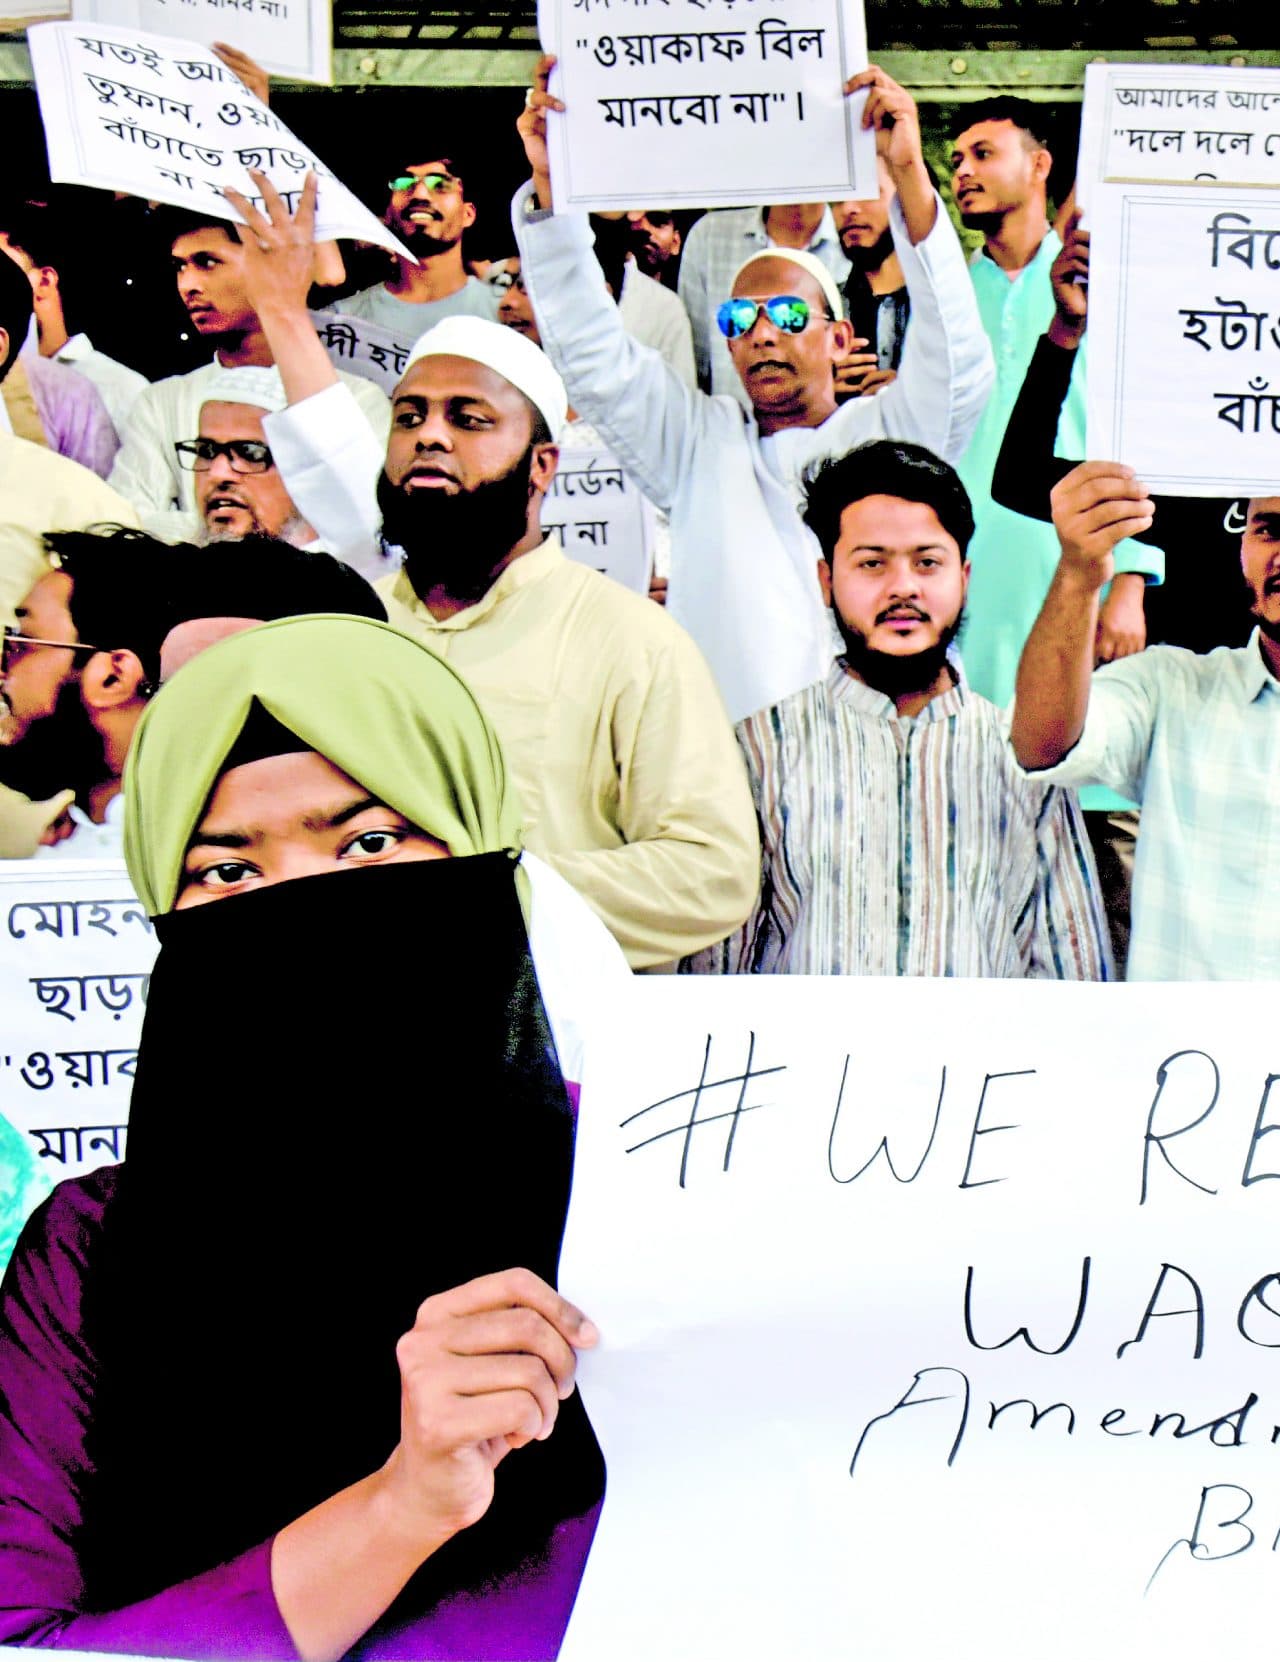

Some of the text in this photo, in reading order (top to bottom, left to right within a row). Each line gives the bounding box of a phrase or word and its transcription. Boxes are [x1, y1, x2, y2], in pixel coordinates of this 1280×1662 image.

[74, 36, 164, 78] যতই
[576, 18, 825, 68] "ওয়াকাফ বিল
[82, 72, 283, 133] তুফান, ওয়া
[597, 94, 722, 128] মানবো
[1114, 88, 1219, 108] আমাদের
[98, 115, 224, 169] বাঁচাতে
[1193, 131, 1255, 155] দলে
[153, 164, 195, 192] না
[317, 322, 360, 359] দী
[552, 457, 626, 497] ার্ডেন
[28, 973, 151, 1022] ছাড়
[28, 1125, 128, 1164] মান
